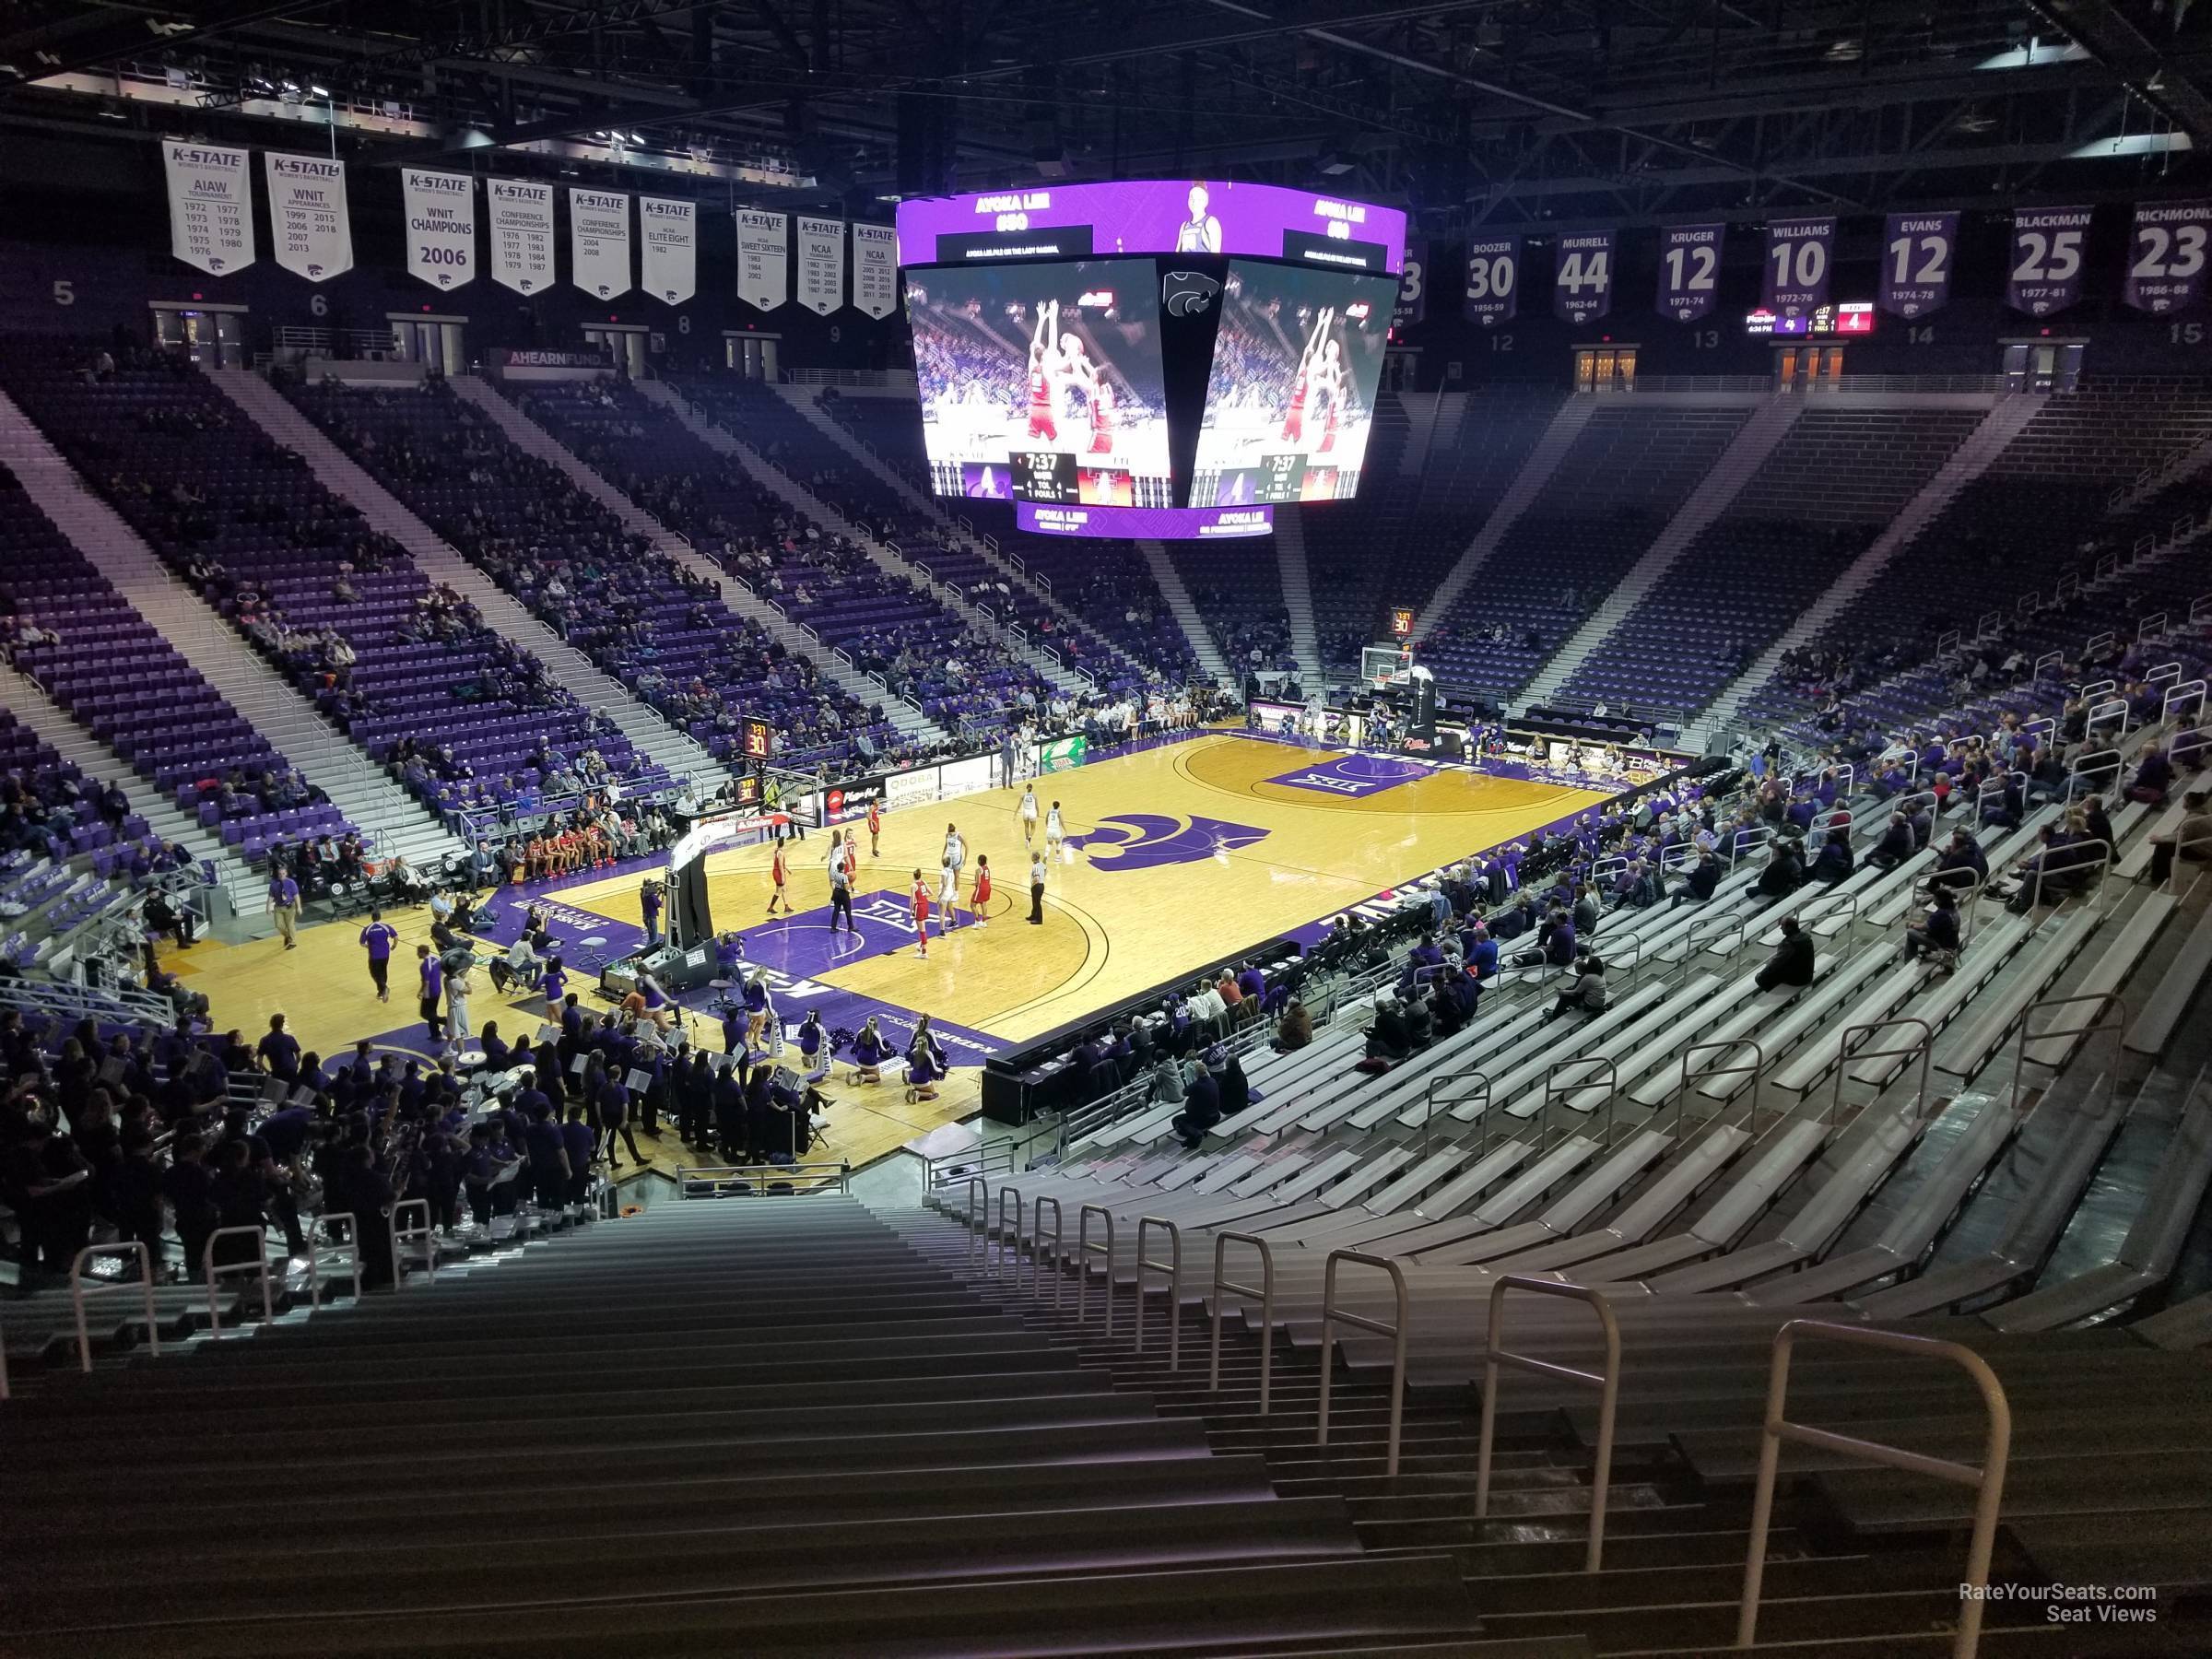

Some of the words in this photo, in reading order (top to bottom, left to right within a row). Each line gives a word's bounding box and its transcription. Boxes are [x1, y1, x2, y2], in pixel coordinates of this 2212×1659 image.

[172, 148, 241, 167] K-STATE
[205, 164, 238, 173] BASKETBALL
[274, 159, 339, 176] K-STATE
[194, 180, 227, 193] AIAW
[410, 174, 467, 192] K-STATE
[188, 191, 232, 200] TOURNAMENT
[293, 189, 324, 201] WNIT
[494, 184, 547, 201] K-STATE
[288, 199, 331, 209] APPEARANCES
[575, 194, 623, 209] K-STATE
[185, 202, 206, 212] 1972
[217, 206, 238, 215] 1977
[427, 207, 454, 219] WNIT
[645, 202, 690, 217] K-STATE
[185, 213, 207, 223] 1973
[218, 216, 240, 226] 1978
[286, 210, 306, 220] 1999
[314, 213, 335, 223] 2015
[501, 210, 544, 221] CONFERENCE
[741, 213, 782, 228] K-STATE
[2015, 214, 2091, 228] BLACKMAN
[287, 221, 308, 231] 2006
[315, 224, 336, 233] 2018
[411, 218, 472, 234] CHAMPIONS
[496, 218, 549, 229] CHAMPIONSHIPS
[582, 219, 620, 229] CONFERENCE
[802, 221, 841, 234] K-STATE
[1900, 220, 1943, 232] EVANS
[186, 224, 208, 234] 1974
[219, 227, 241, 237] 1979
[288, 232, 308, 241] 2007
[502, 231, 520, 240] 1976
[527, 233, 544, 241] 1982
[577, 226, 626, 237] CHAMPIONSHIPS
[858, 229, 893, 241] K-STATE
[1671, 231, 1714, 243] KRUGER
[1773, 225, 1830, 238] WILLIAMS
[188, 235, 210, 245] 1975
[220, 238, 242, 249] 1980
[582, 239, 599, 247] 2004
[649, 232, 668, 241] ELITE
[668, 234, 688, 244] EIGHT
[1562, 237, 1609, 249] MURRELL
[190, 246, 211, 255] 1976
[288, 243, 310, 253] 2013
[503, 241, 520, 250] 1977
[527, 243, 545, 252] 1983
[583, 248, 599, 256] 2008
[741, 241, 762, 252] SWEET
[762, 243, 785, 253] SIXTEEN
[811, 244, 831, 254] NCAA
[1474, 242, 1512, 254] BOOZER
[2131, 226, 2207, 277] 23
[420, 246, 466, 265] 2006
[504, 251, 521, 259] 1978
[528, 253, 546, 261] 1984
[865, 250, 885, 260] NCAA
[1890, 236, 1947, 283] 12
[2012, 231, 2082, 280] 25
[505, 261, 522, 269] 1979
[529, 263, 546, 271] 1987
[1666, 246, 1716, 290] 12
[1771, 241, 1826, 287] 10
[1466, 256, 1514, 299] 30
[1558, 252, 1608, 294] 44
[53, 281, 75, 305] 5
[1891, 290, 1935, 300] 1974-78
[2020, 288, 2065, 298] 1977-81
[2139, 285, 2189, 296] 1986-88
[311, 294, 328, 316] 6
[1565, 300, 1597, 310] 1962-64
[1669, 297, 1704, 306] 1971-74
[1776, 294, 1814, 303] 1972-76
[1474, 303, 1504, 312] 1956-59
[678, 315, 690, 335] 8
[1848, 313, 1859, 329] 4
[830, 326, 841, 343] 9
[1694, 331, 1718, 348] 13
[1909, 326, 1934, 344] 14
[2171, 323, 2203, 344] 15
[1492, 335, 1513, 351] 12
[1026, 453, 1057, 470] 7:37
[1271, 456, 1295, 472] 7:37
[981, 466, 995, 494] 4
[1038, 481, 1051, 489] TOL
[1230, 472, 1244, 501] 4
[1034, 489, 1055, 499] FOULS
[1394, 620, 1408, 632] 30
[751, 724, 765, 735] 7:37
[750, 735, 765, 753] 30
[890, 773, 933, 790] QDOBA
[741, 789, 752, 797] 30
[843, 792, 865, 804] Pizza
[865, 787, 880, 798] Hut
[1174, 1006, 1186, 1018] 20
[774, 1024, 783, 1055] K-STATE
[821, 1043, 831, 1074] K-STATE
